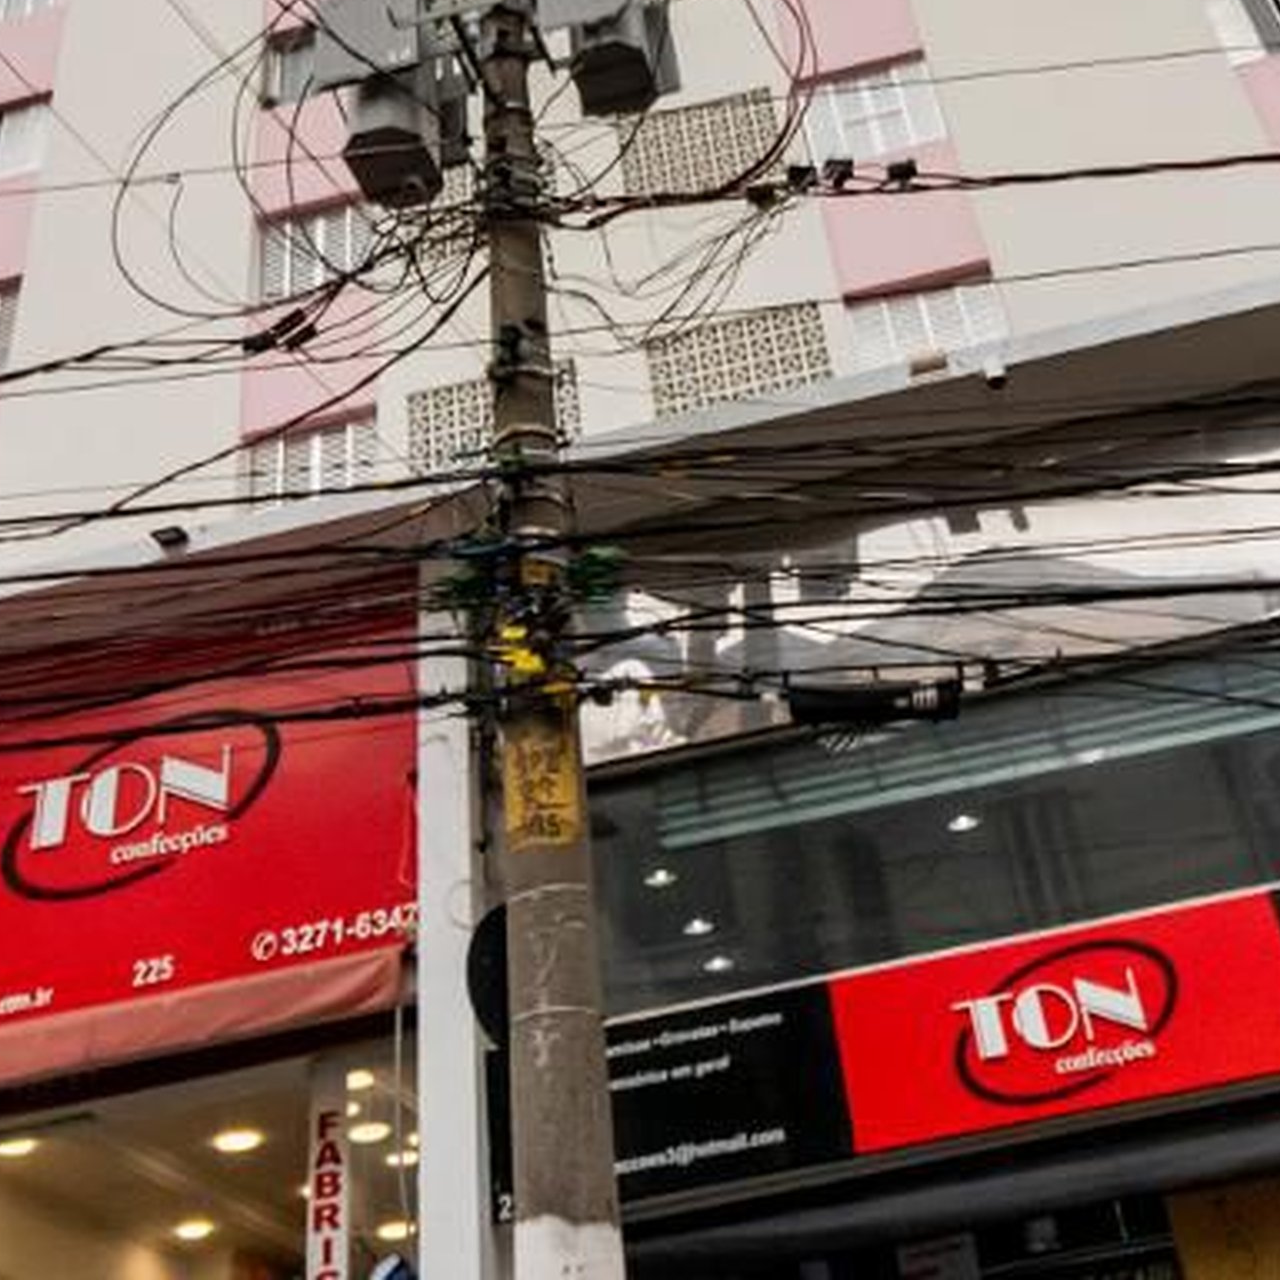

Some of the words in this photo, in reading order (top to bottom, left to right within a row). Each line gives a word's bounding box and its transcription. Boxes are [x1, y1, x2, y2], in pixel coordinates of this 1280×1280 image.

[17, 744, 232, 851] TON
[111, 823, 229, 864] confecções
[132, 955, 174, 987] 225
[950, 966, 1148, 1061] TON
